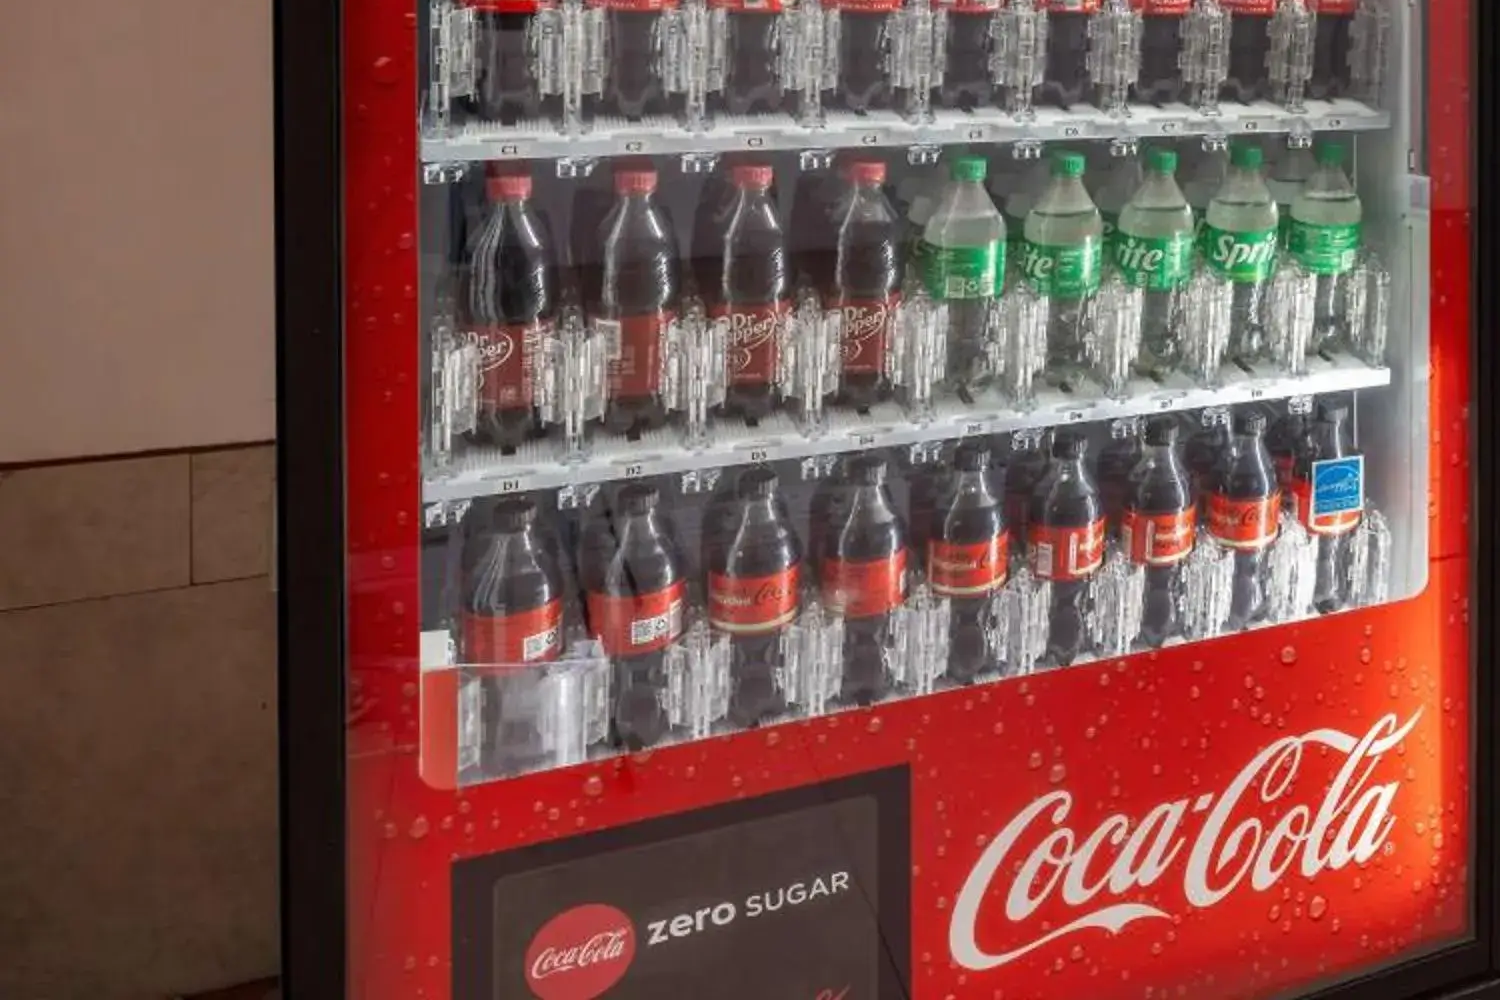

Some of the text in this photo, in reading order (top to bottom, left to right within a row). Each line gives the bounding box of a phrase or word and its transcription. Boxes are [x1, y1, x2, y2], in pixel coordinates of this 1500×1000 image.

[1024, 244, 1053, 278] ite
[1117, 238, 1163, 271] rite
[731, 313, 755, 331] Dr
[732, 319, 774, 343] pper
[844, 306, 868, 324] Dr
[844, 311, 886, 338] pper
[948, 703, 1427, 971] Coca-Cola
[646, 869, 850, 946] zero SUGAR
[531, 924, 634, 980] Coca-Cola
